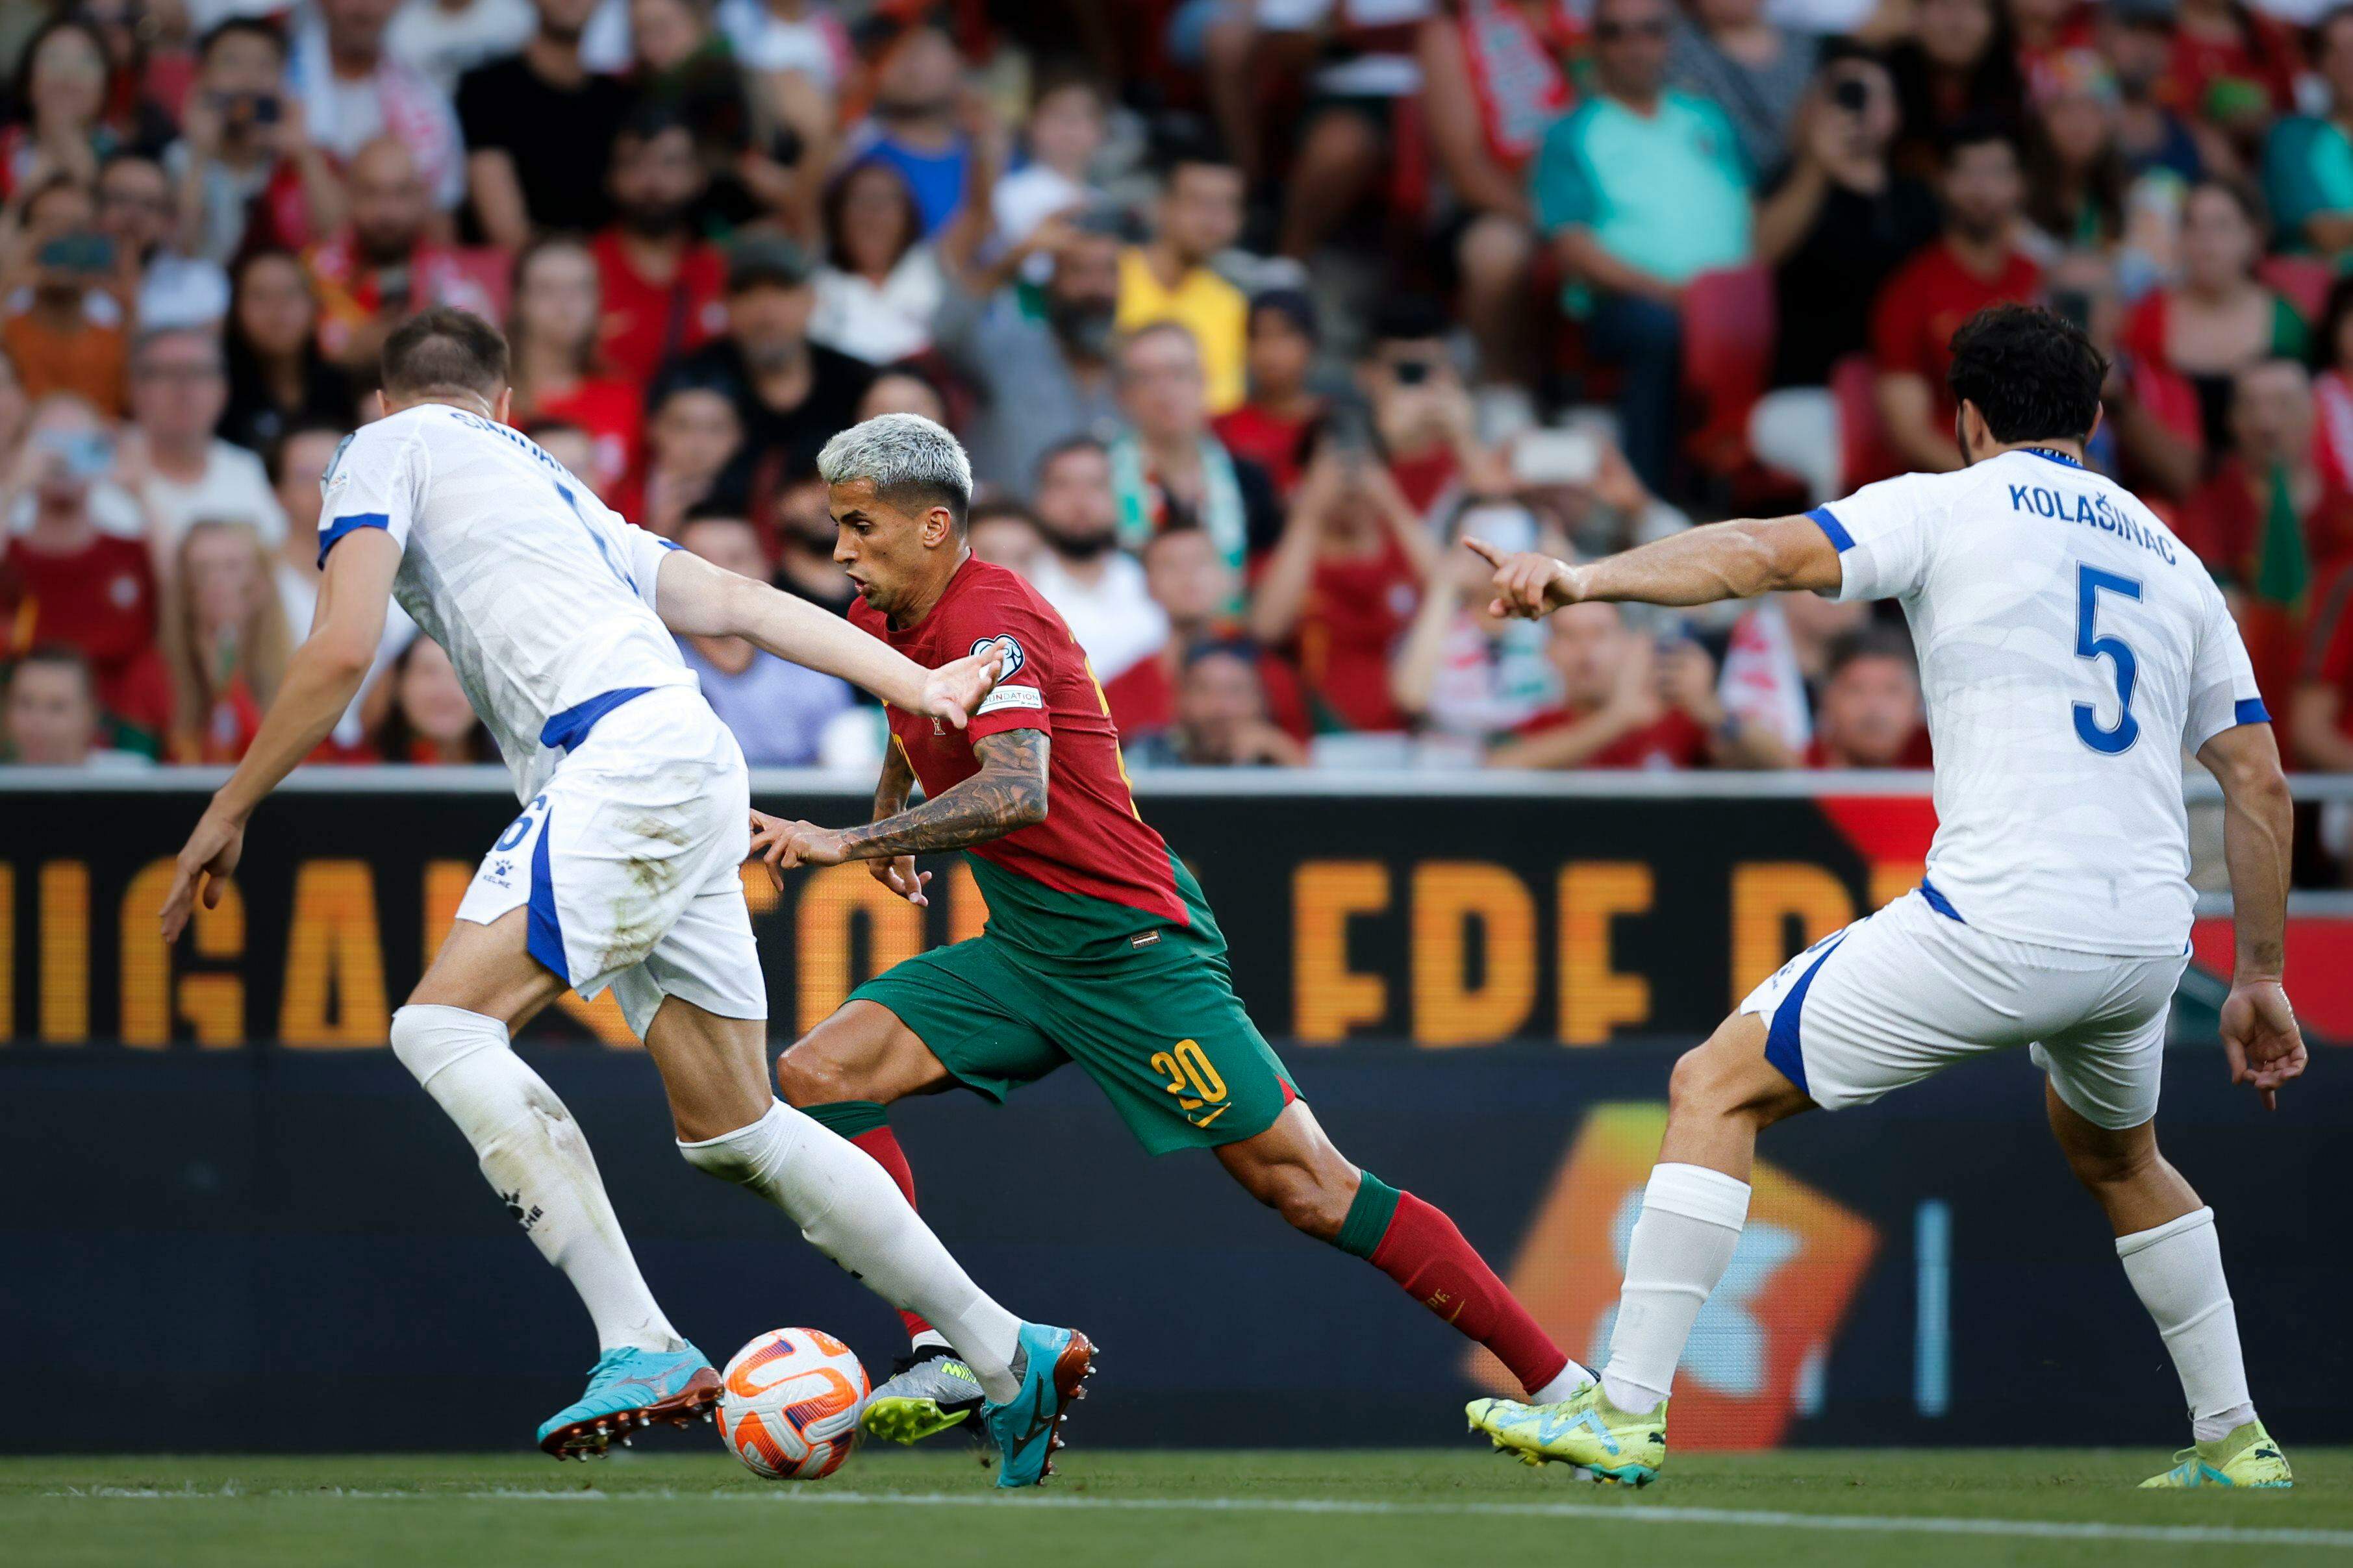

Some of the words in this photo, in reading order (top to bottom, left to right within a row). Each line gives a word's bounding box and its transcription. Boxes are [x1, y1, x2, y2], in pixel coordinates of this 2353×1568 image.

[2008, 484, 2176, 566] KOLAŠINAC
[984, 692, 1039, 703] UNDATION
[2071, 559, 2143, 756] 5
